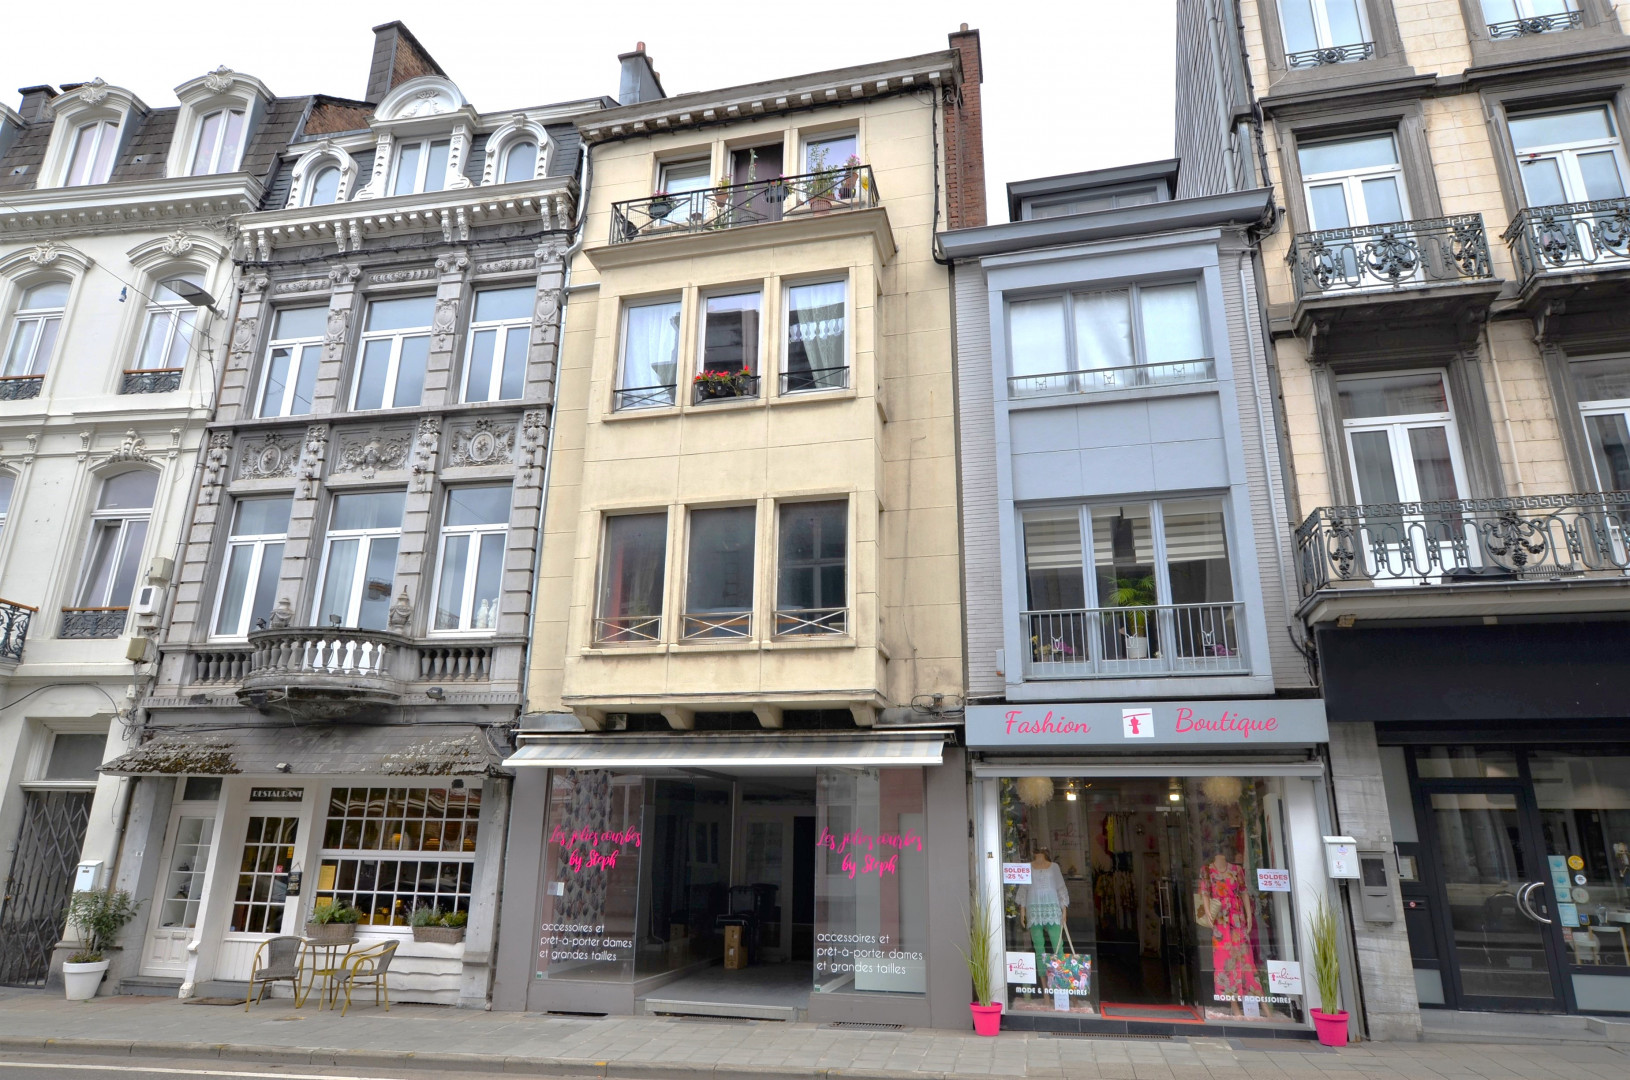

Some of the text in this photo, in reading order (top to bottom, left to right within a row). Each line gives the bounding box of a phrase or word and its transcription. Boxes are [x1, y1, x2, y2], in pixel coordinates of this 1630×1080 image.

[1004, 707, 1279, 739] Fashion Boutique
[252, 790, 302, 798] RESTAURANT
[549, 824, 565, 846] Les
[601, 825, 641, 847] courbes
[816, 826, 836, 850] Les
[876, 828, 923, 852] courbes
[569, 848, 619, 873] by Steph
[841, 853, 899, 880] by Steph
[541, 923, 605, 934] accessoires et
[540, 935, 633, 949] prêt-à-porter dames
[817, 933, 890, 945] accessoires et
[539, 949, 617, 962] et grandes tailles
[816, 946, 923, 961] prêt-à-porter dames
[816, 961, 906, 976] et grandes tailles
[1015, 986, 1088, 996] MODE & ACCESSOIRES
[1213, 994, 1236, 1002] MODE
[1244, 995, 1292, 1004] ACCESSOIRES
